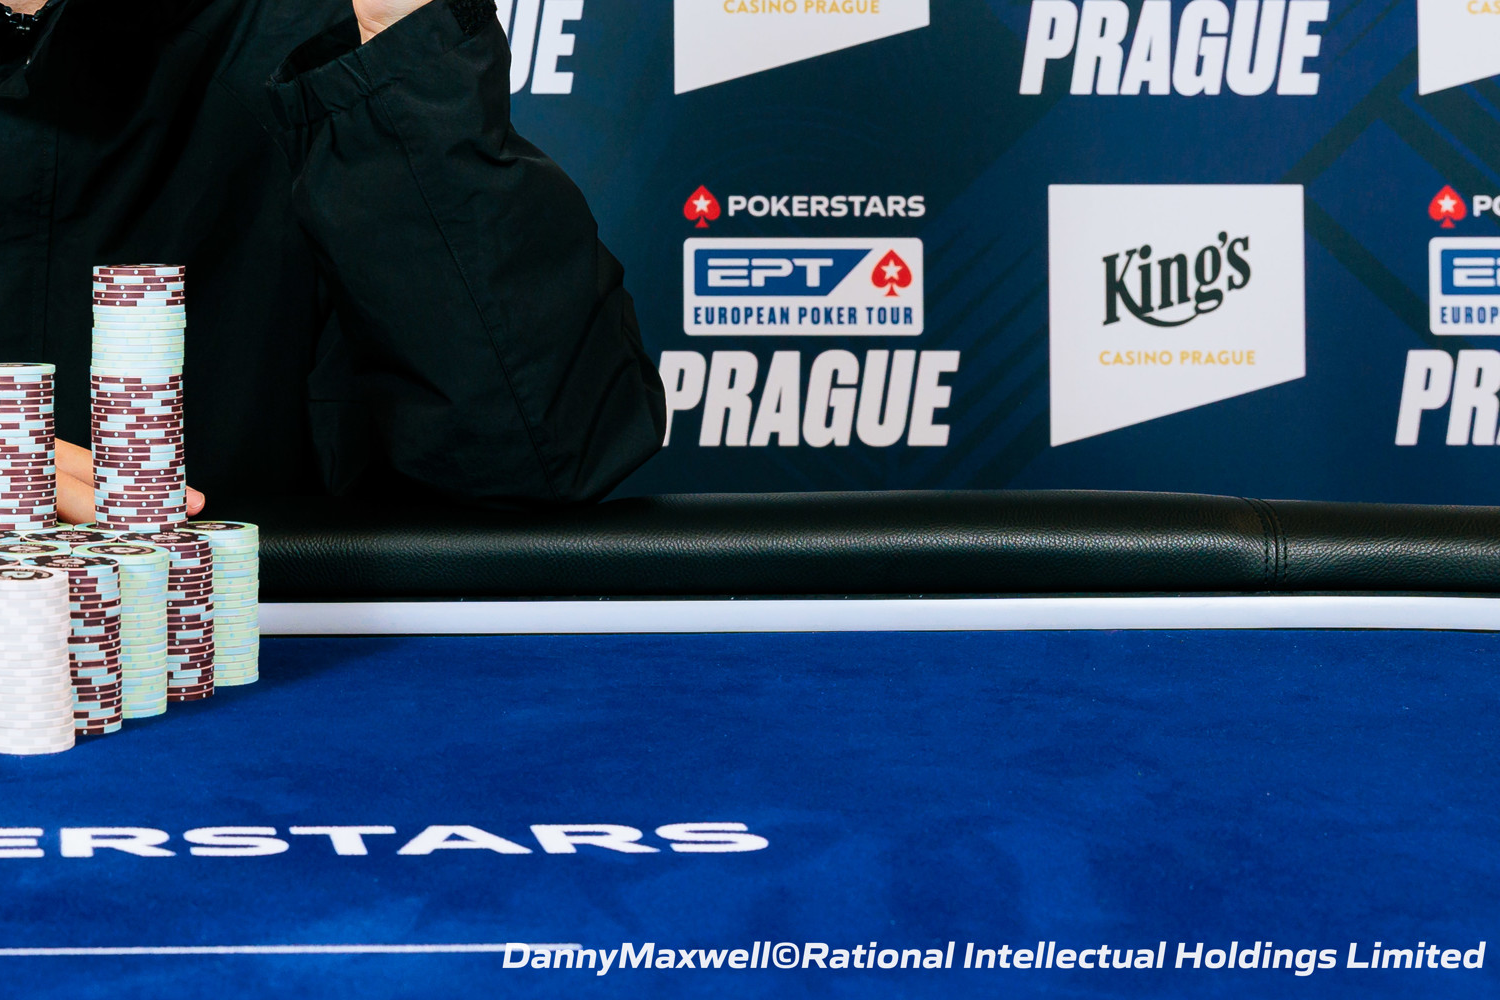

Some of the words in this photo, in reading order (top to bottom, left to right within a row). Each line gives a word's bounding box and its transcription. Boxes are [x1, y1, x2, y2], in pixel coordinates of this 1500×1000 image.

[723, 0, 797, 14] CASINO
[804, 0, 879, 14] PRAGUE
[1020, 0, 1329, 96] PRAGUE
[729, 196, 925, 216] POKERSTARS
[708, 259, 832, 286] EPT
[1103, 232, 1250, 327] King's
[694, 306, 789, 325] EUROPEAN
[798, 306, 857, 325] POKER
[866, 307, 913, 325] TOUR
[1099, 350, 1173, 366] CASINO
[1180, 350, 1255, 365] PRAGUE
[658, 350, 960, 448] PRAGUE
